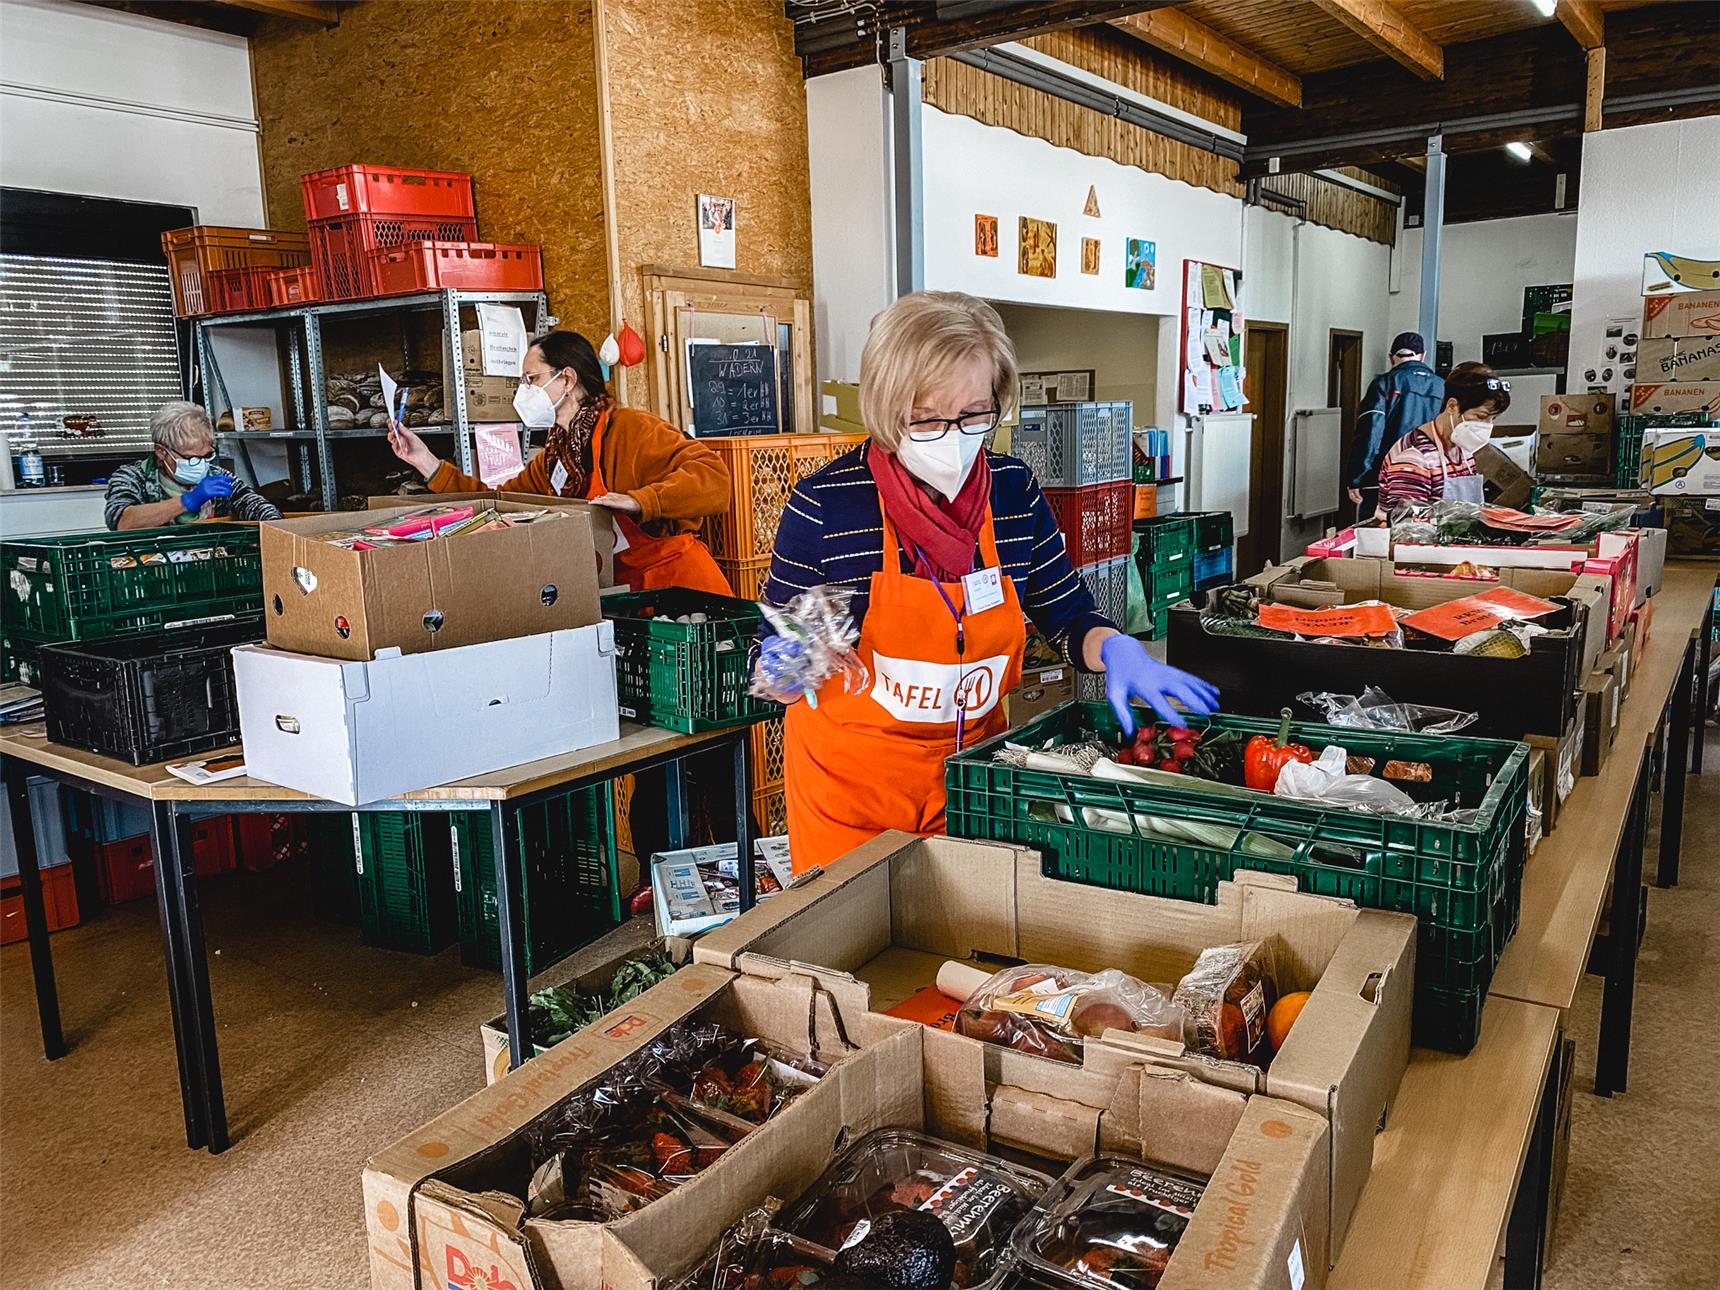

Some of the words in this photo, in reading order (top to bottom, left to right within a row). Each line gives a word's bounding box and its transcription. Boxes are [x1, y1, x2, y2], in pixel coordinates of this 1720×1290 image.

[1678, 300, 1720, 310] BANANEN
[719, 360, 764, 378] WADERN
[1661, 343, 1720, 372] BANANAS
[1664, 386, 1705, 396] BANANEN
[881, 672, 942, 709] TAFEL
[608, 1015, 647, 1038] Dole
[1225, 1159, 1263, 1196] Gold
[1204, 1196, 1256, 1270] Tropical
